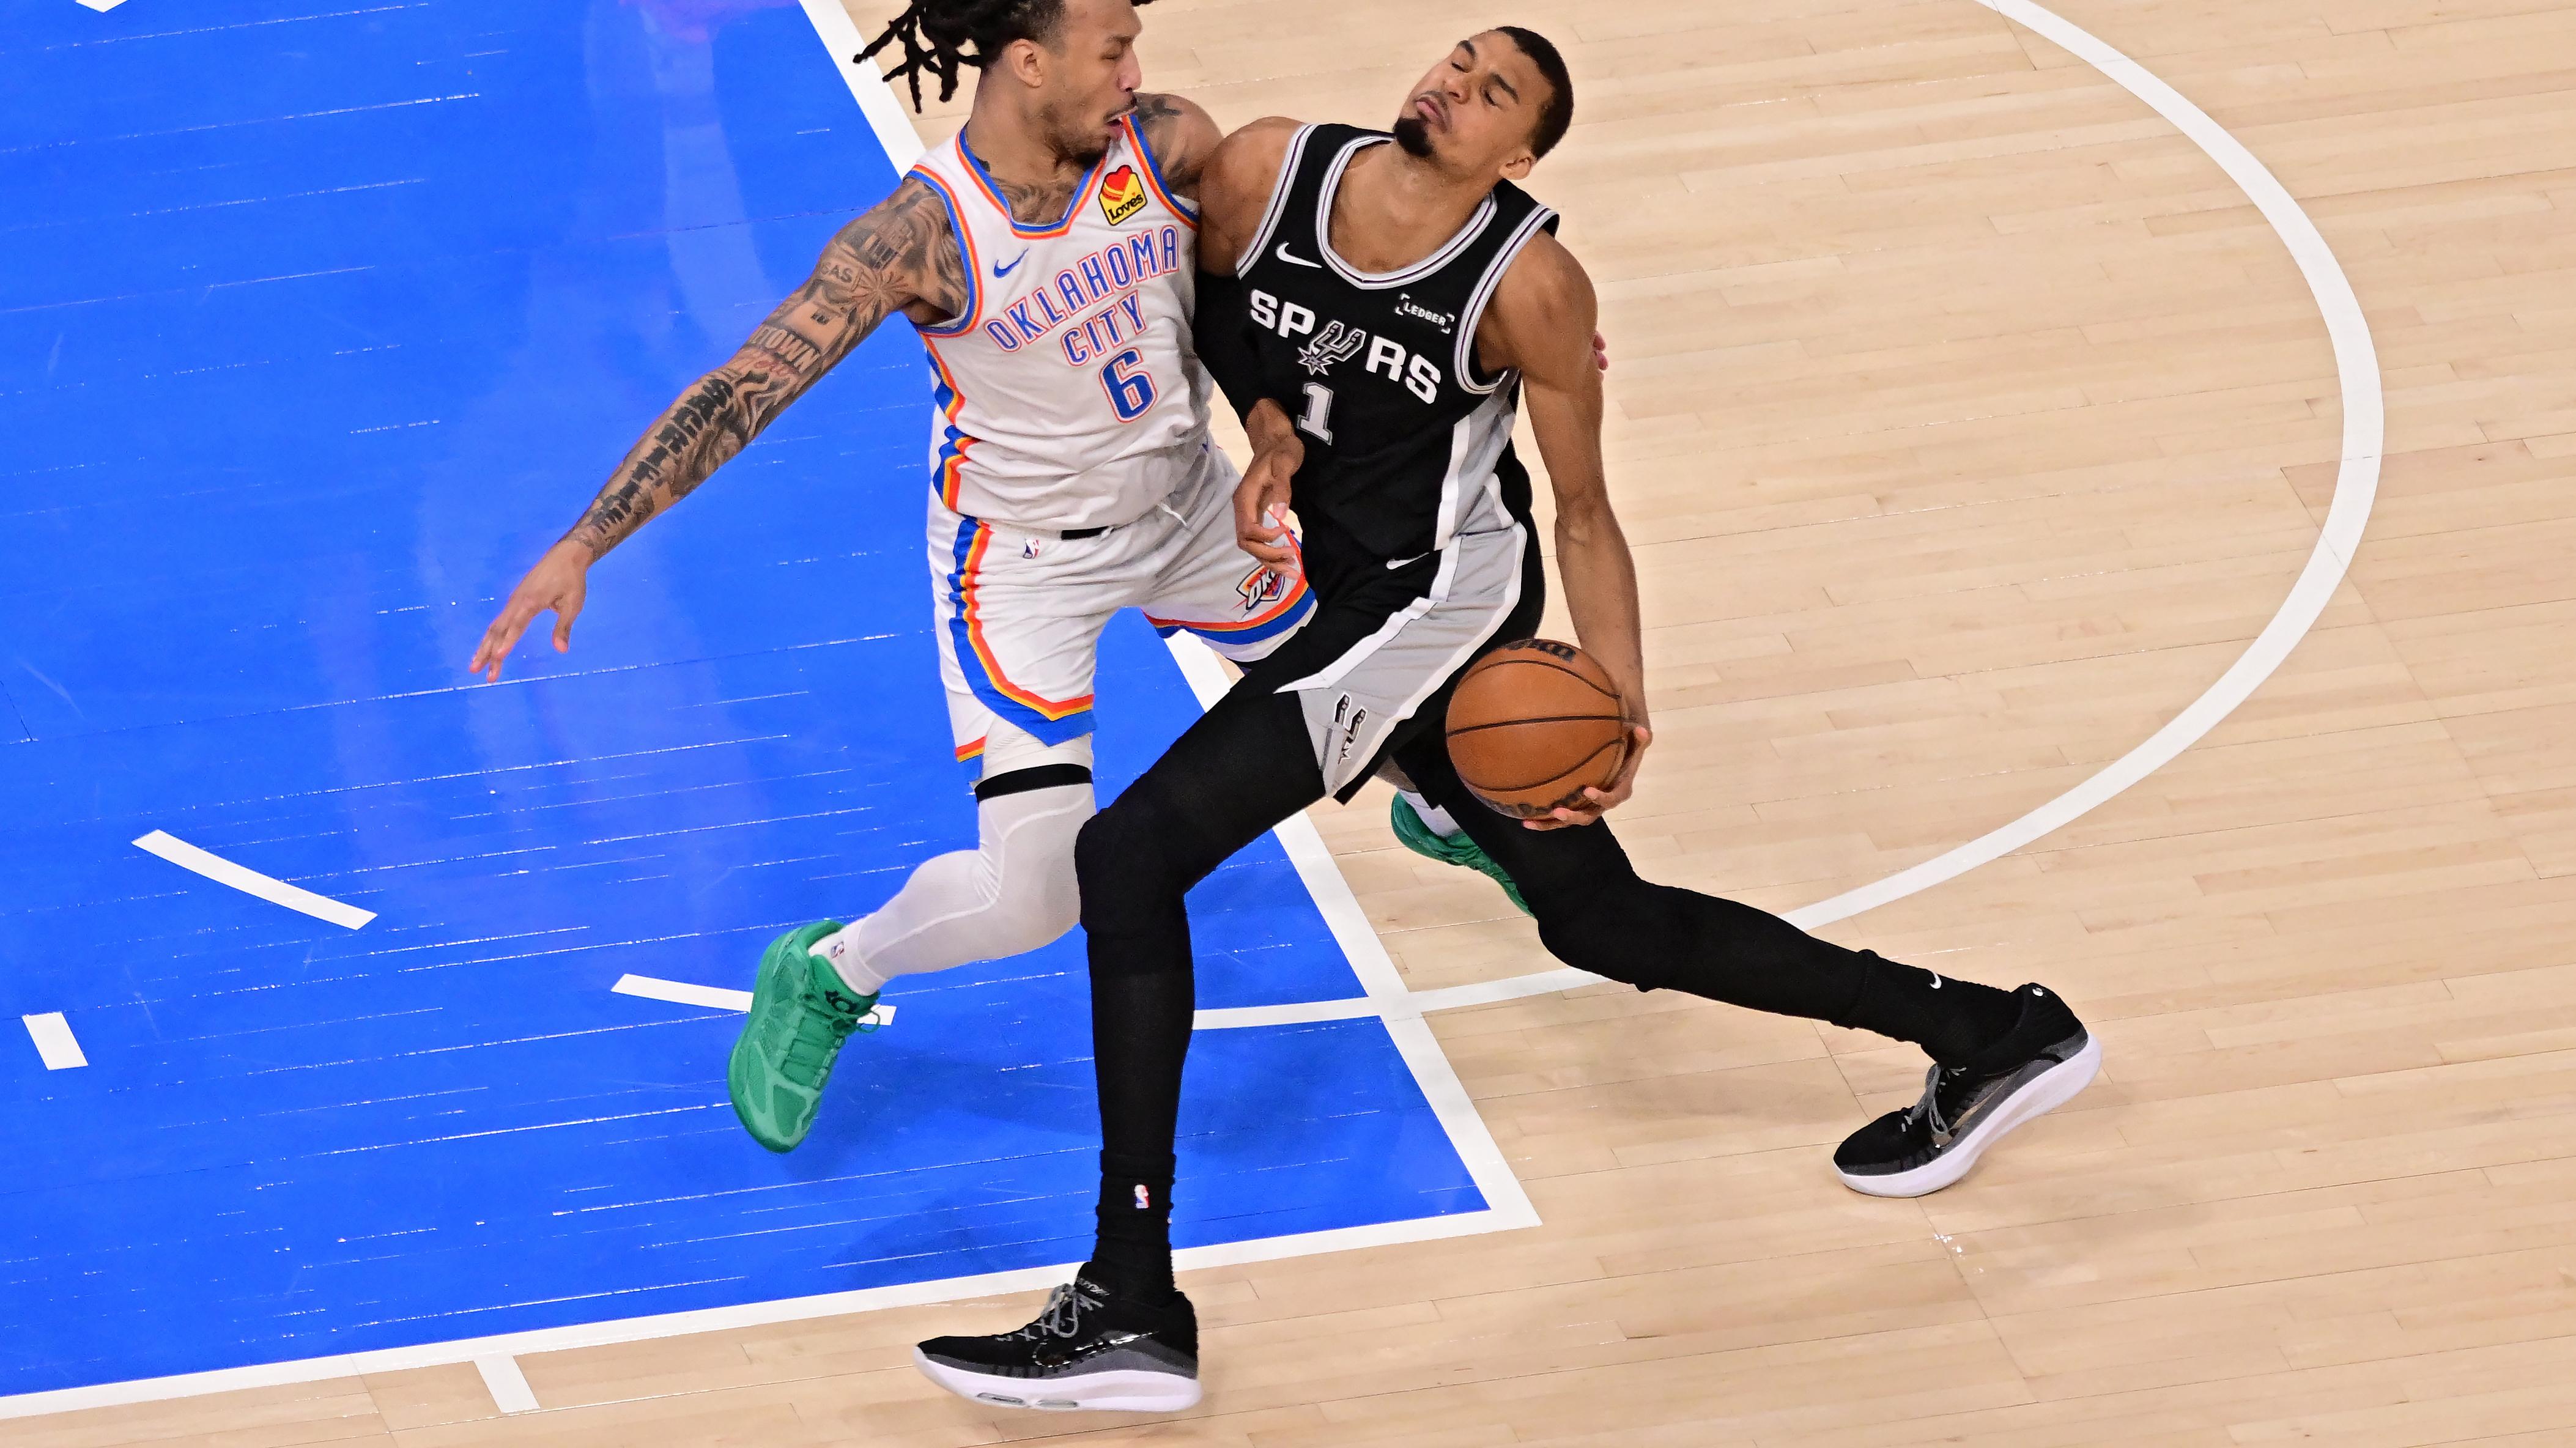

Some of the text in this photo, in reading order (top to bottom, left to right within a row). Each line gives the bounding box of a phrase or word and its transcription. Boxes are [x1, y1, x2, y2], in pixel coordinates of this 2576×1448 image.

[985, 225, 1179, 352] OKLAHOMA
[1404, 301, 1447, 326] LEDGER
[1061, 290, 1146, 366] CITY
[1249, 288, 1442, 405] SPURS
[1100, 347, 1158, 423] 6
[1296, 382, 1334, 446] 1
